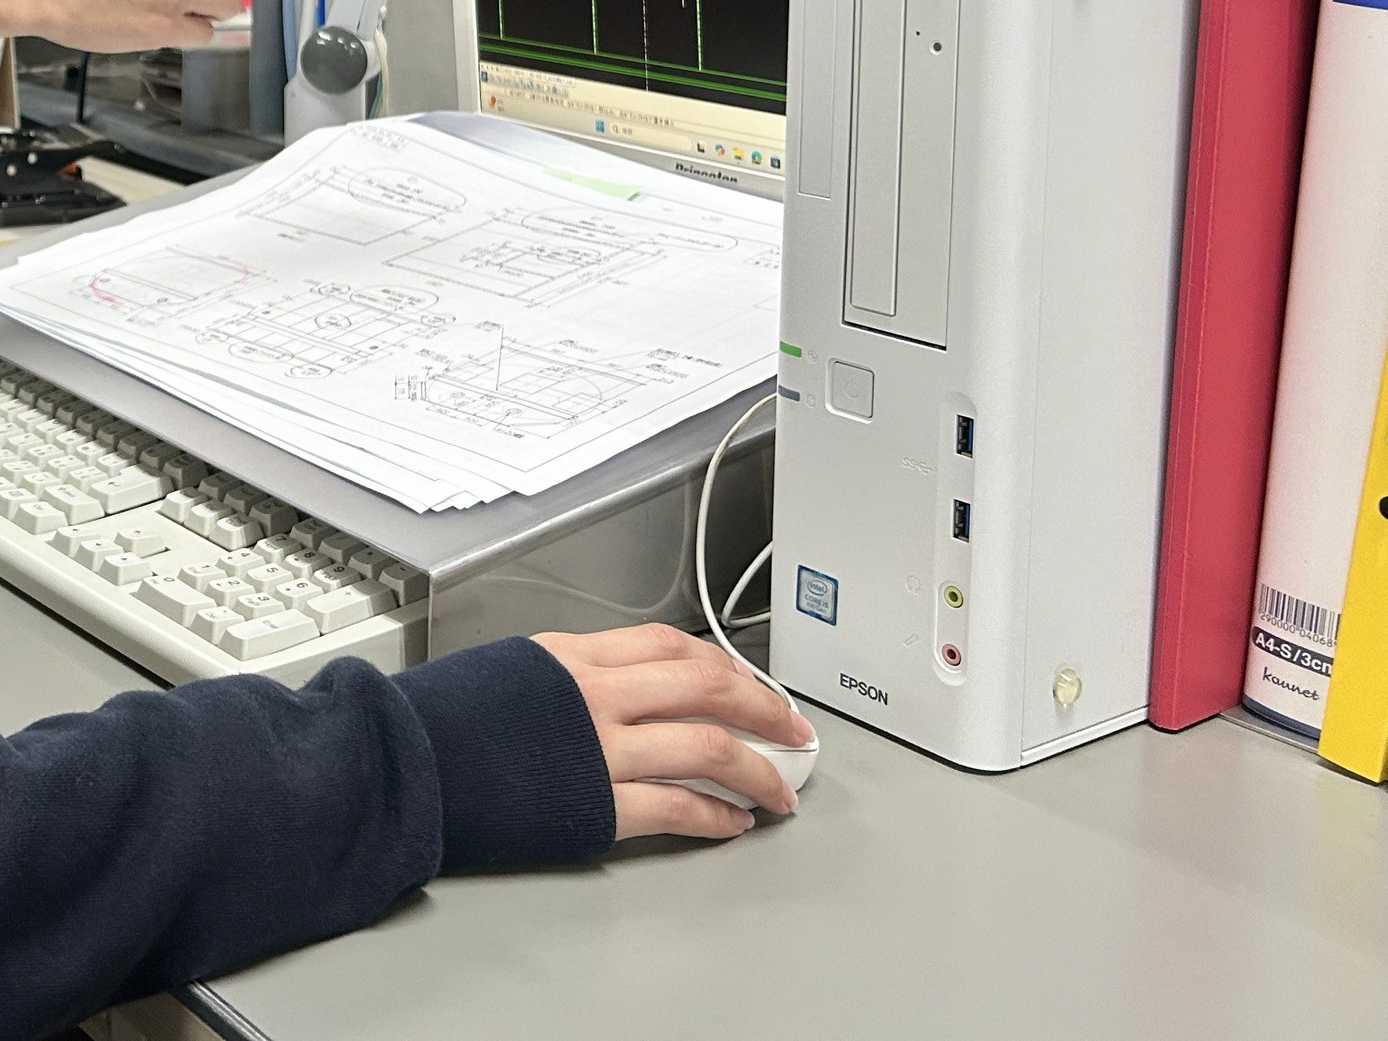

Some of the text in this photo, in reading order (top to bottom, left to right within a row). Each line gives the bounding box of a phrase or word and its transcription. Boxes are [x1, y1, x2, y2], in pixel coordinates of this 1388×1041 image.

[1299, 628, 1338, 648] 04068
[839, 672, 888, 706] EPSON
[1262, 666, 1320, 700] kaunet
